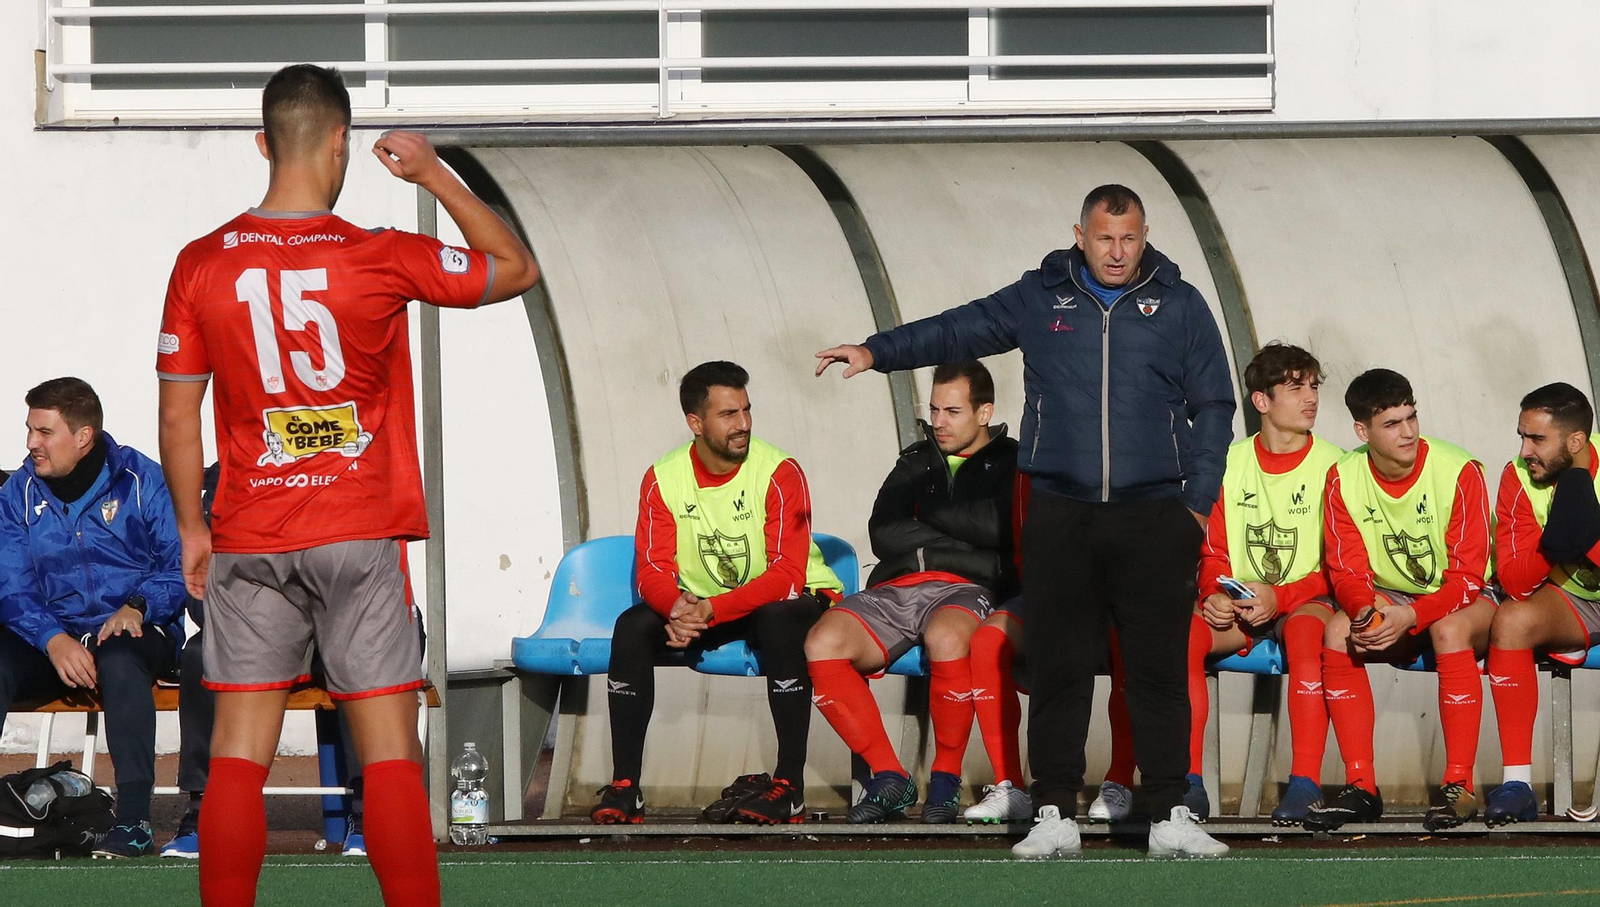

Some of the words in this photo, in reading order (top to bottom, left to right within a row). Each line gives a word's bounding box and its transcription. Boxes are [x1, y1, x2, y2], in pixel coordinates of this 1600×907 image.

[240, 233, 284, 245] DENTAL
[287, 234, 346, 246] COMPANY
[235, 267, 346, 394] 15
[286, 420, 343, 434] COME
[295, 433, 344, 450] BEBE
[249, 477, 283, 488] VAPO
[732, 509, 754, 522] wop!
[1288, 505, 1311, 516] wop!
